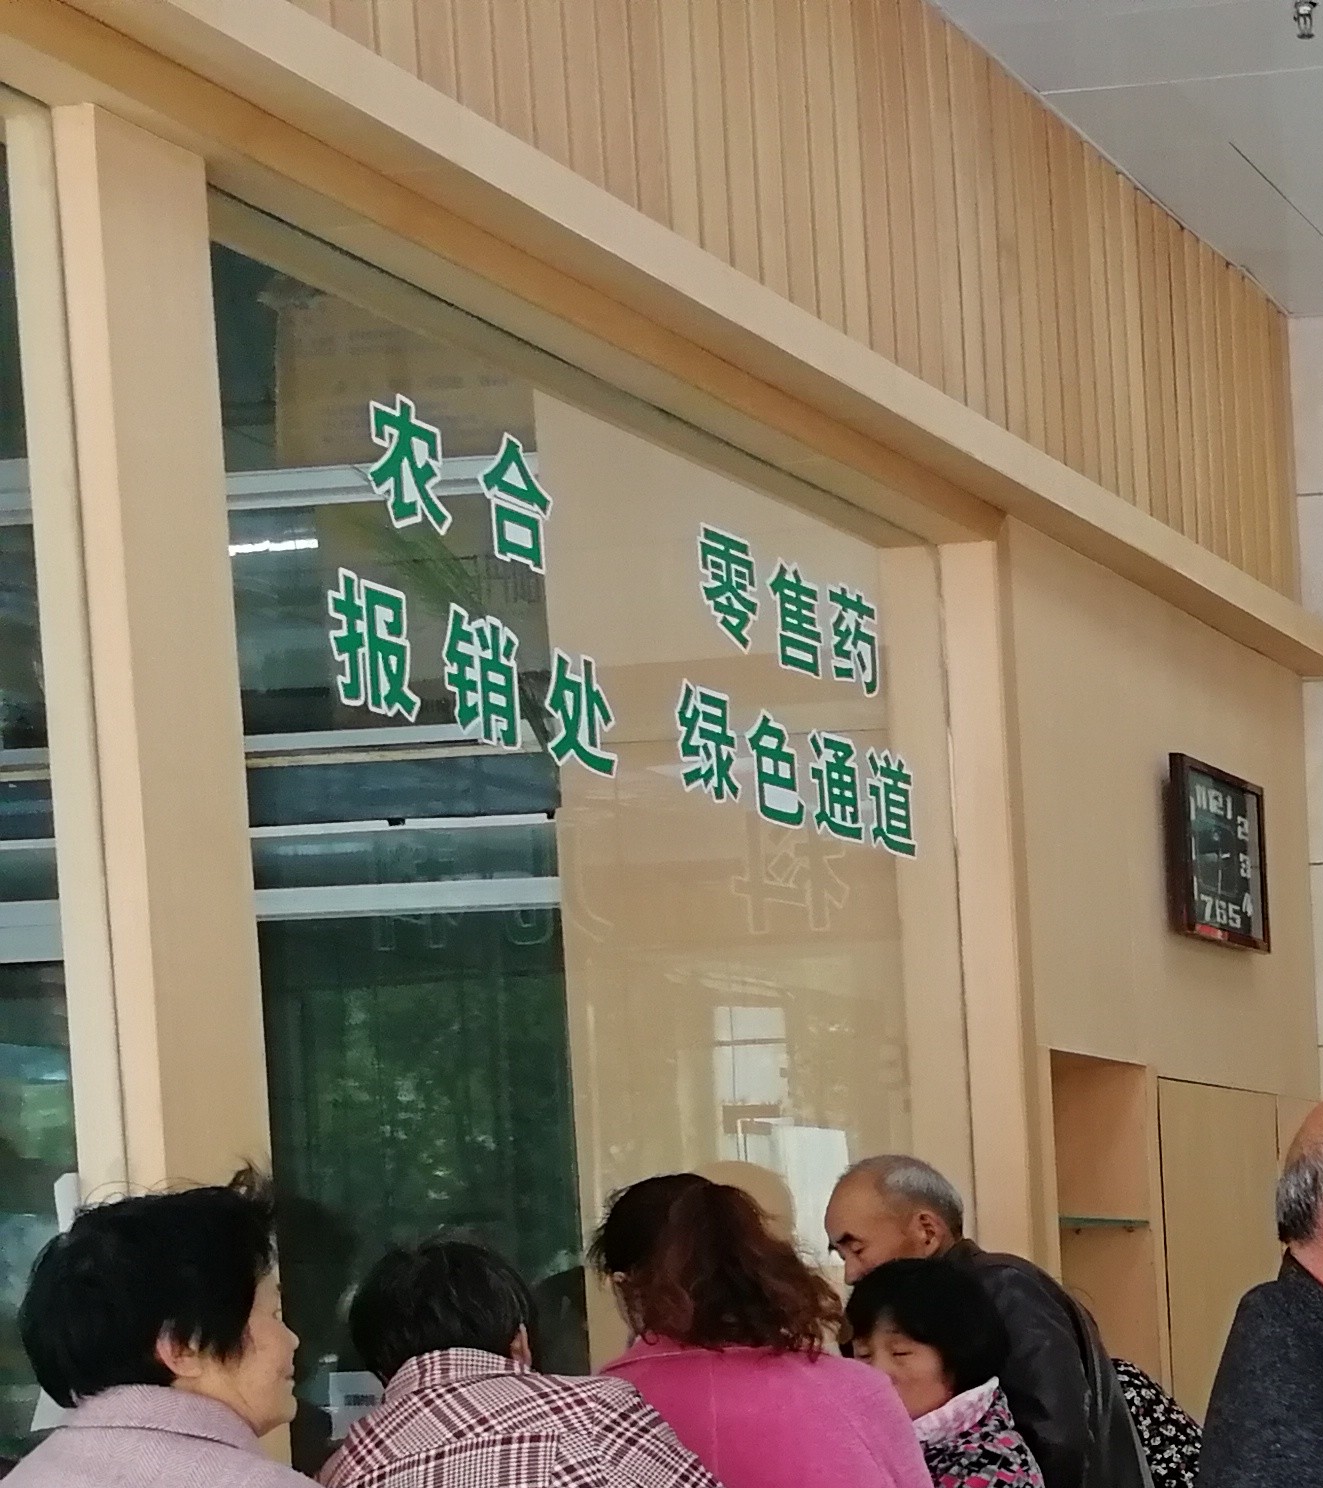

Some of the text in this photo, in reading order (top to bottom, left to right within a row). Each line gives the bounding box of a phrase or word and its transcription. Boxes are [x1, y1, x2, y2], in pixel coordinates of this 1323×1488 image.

[369, 394, 552, 574] 农合
[327, 568, 617, 778] 报销处
[697, 523, 879, 698] 零售药
[677, 679, 917, 858] 绿色通道
